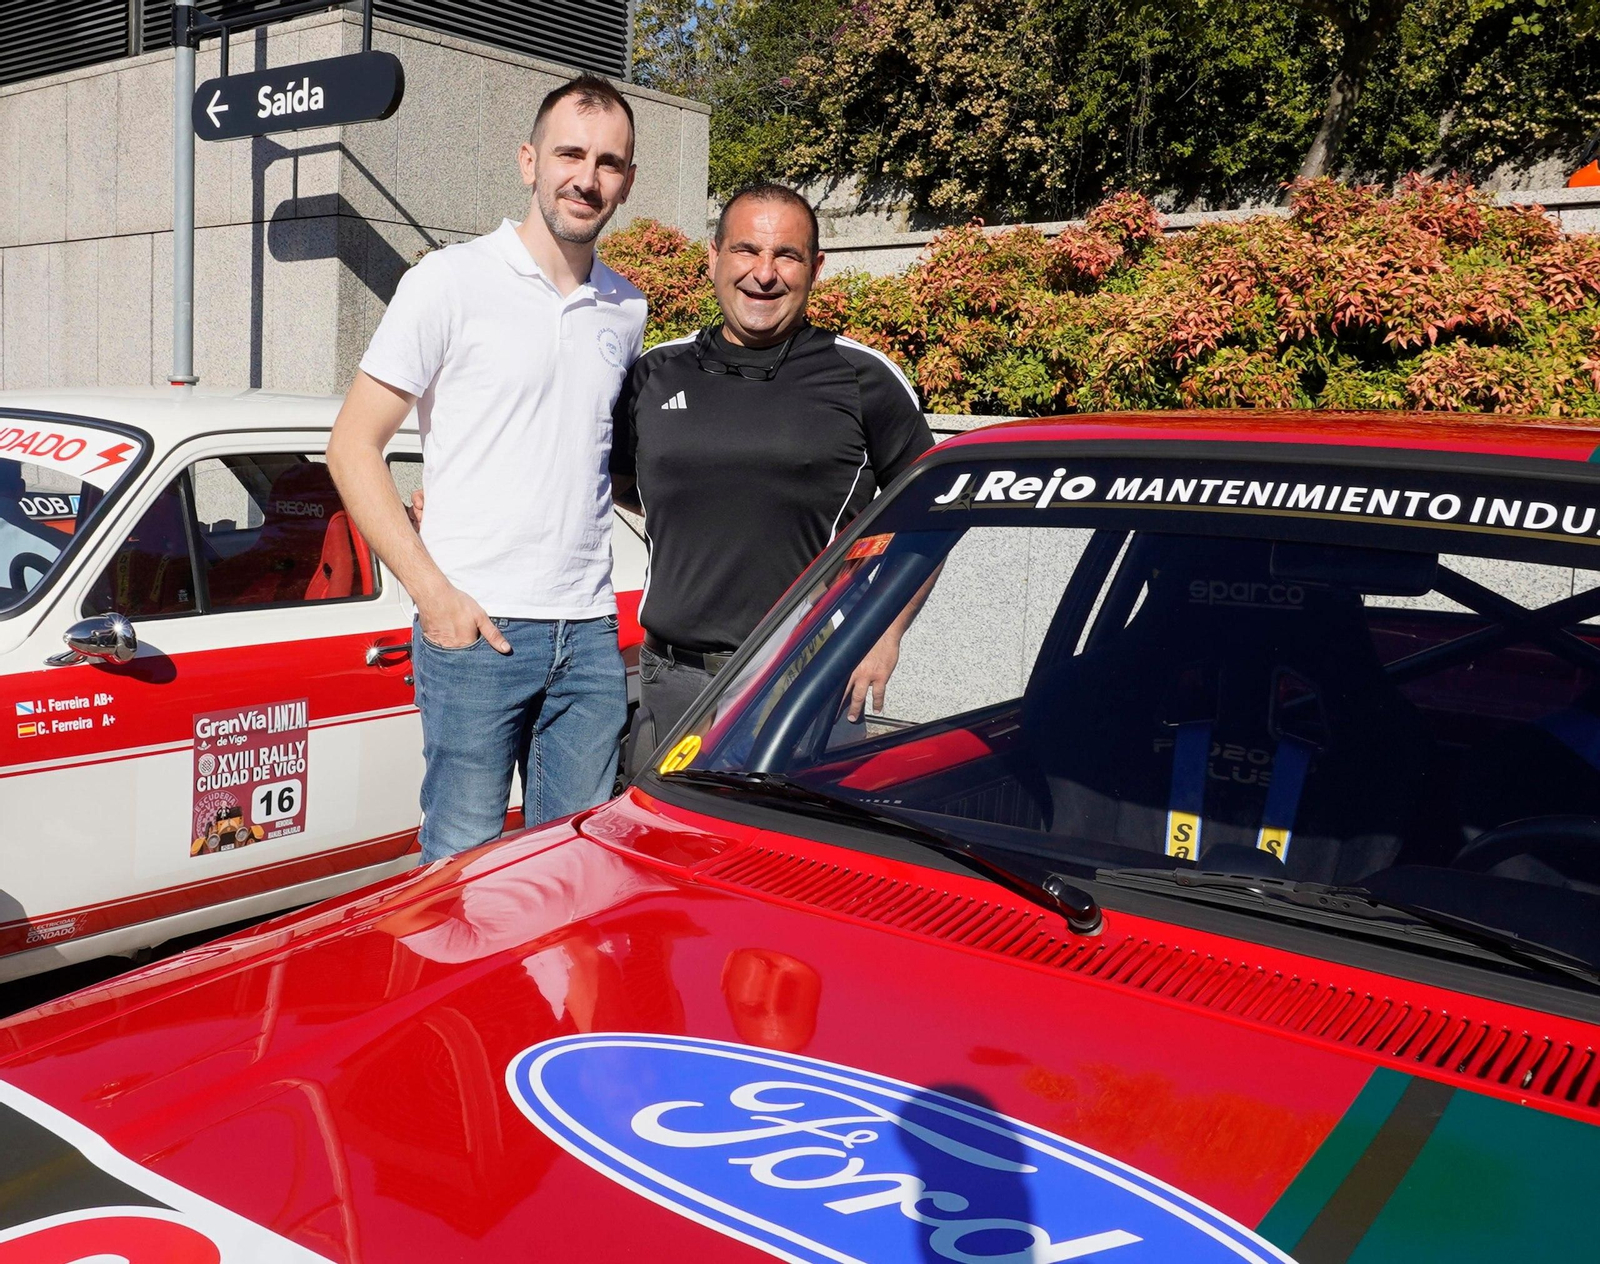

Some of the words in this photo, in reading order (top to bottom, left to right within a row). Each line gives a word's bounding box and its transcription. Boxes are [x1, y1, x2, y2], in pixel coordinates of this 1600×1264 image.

[257, 77, 324, 119] Saída
[276, 500, 325, 519] RECARO
[974, 467, 1097, 509] Rejo
[1105, 477, 1462, 521] MANTENIMIENTO
[1468, 496, 1600, 536] INDU
[1188, 579, 1305, 605] sparco
[35, 699, 46, 714] J.
[48, 696, 91, 712] Ferreira
[93, 692, 114, 707] AB+
[37, 721, 50, 735] C.
[52, 716, 94, 733] Ferreira
[102, 713, 116, 727] A+
[195, 710, 267, 739] GranVía
[267, 701, 308, 735] LANZAL
[216, 736, 228, 747] de
[228, 734, 248, 747] Vigo
[217, 749, 255, 775] XVIII
[259, 740, 306, 767] RALLY
[196, 768, 250, 793] CIUDAD
[253, 764, 271, 782] DE
[273, 758, 306, 778] VIGO
[194, 791, 236, 813] ESCUDERIA
[260, 786, 295, 817] 16
[26, 926, 76, 944] CONDADO
[29, 917, 76, 931] ELECTRICIDAD
[629, 1080, 1144, 1264] Ford
